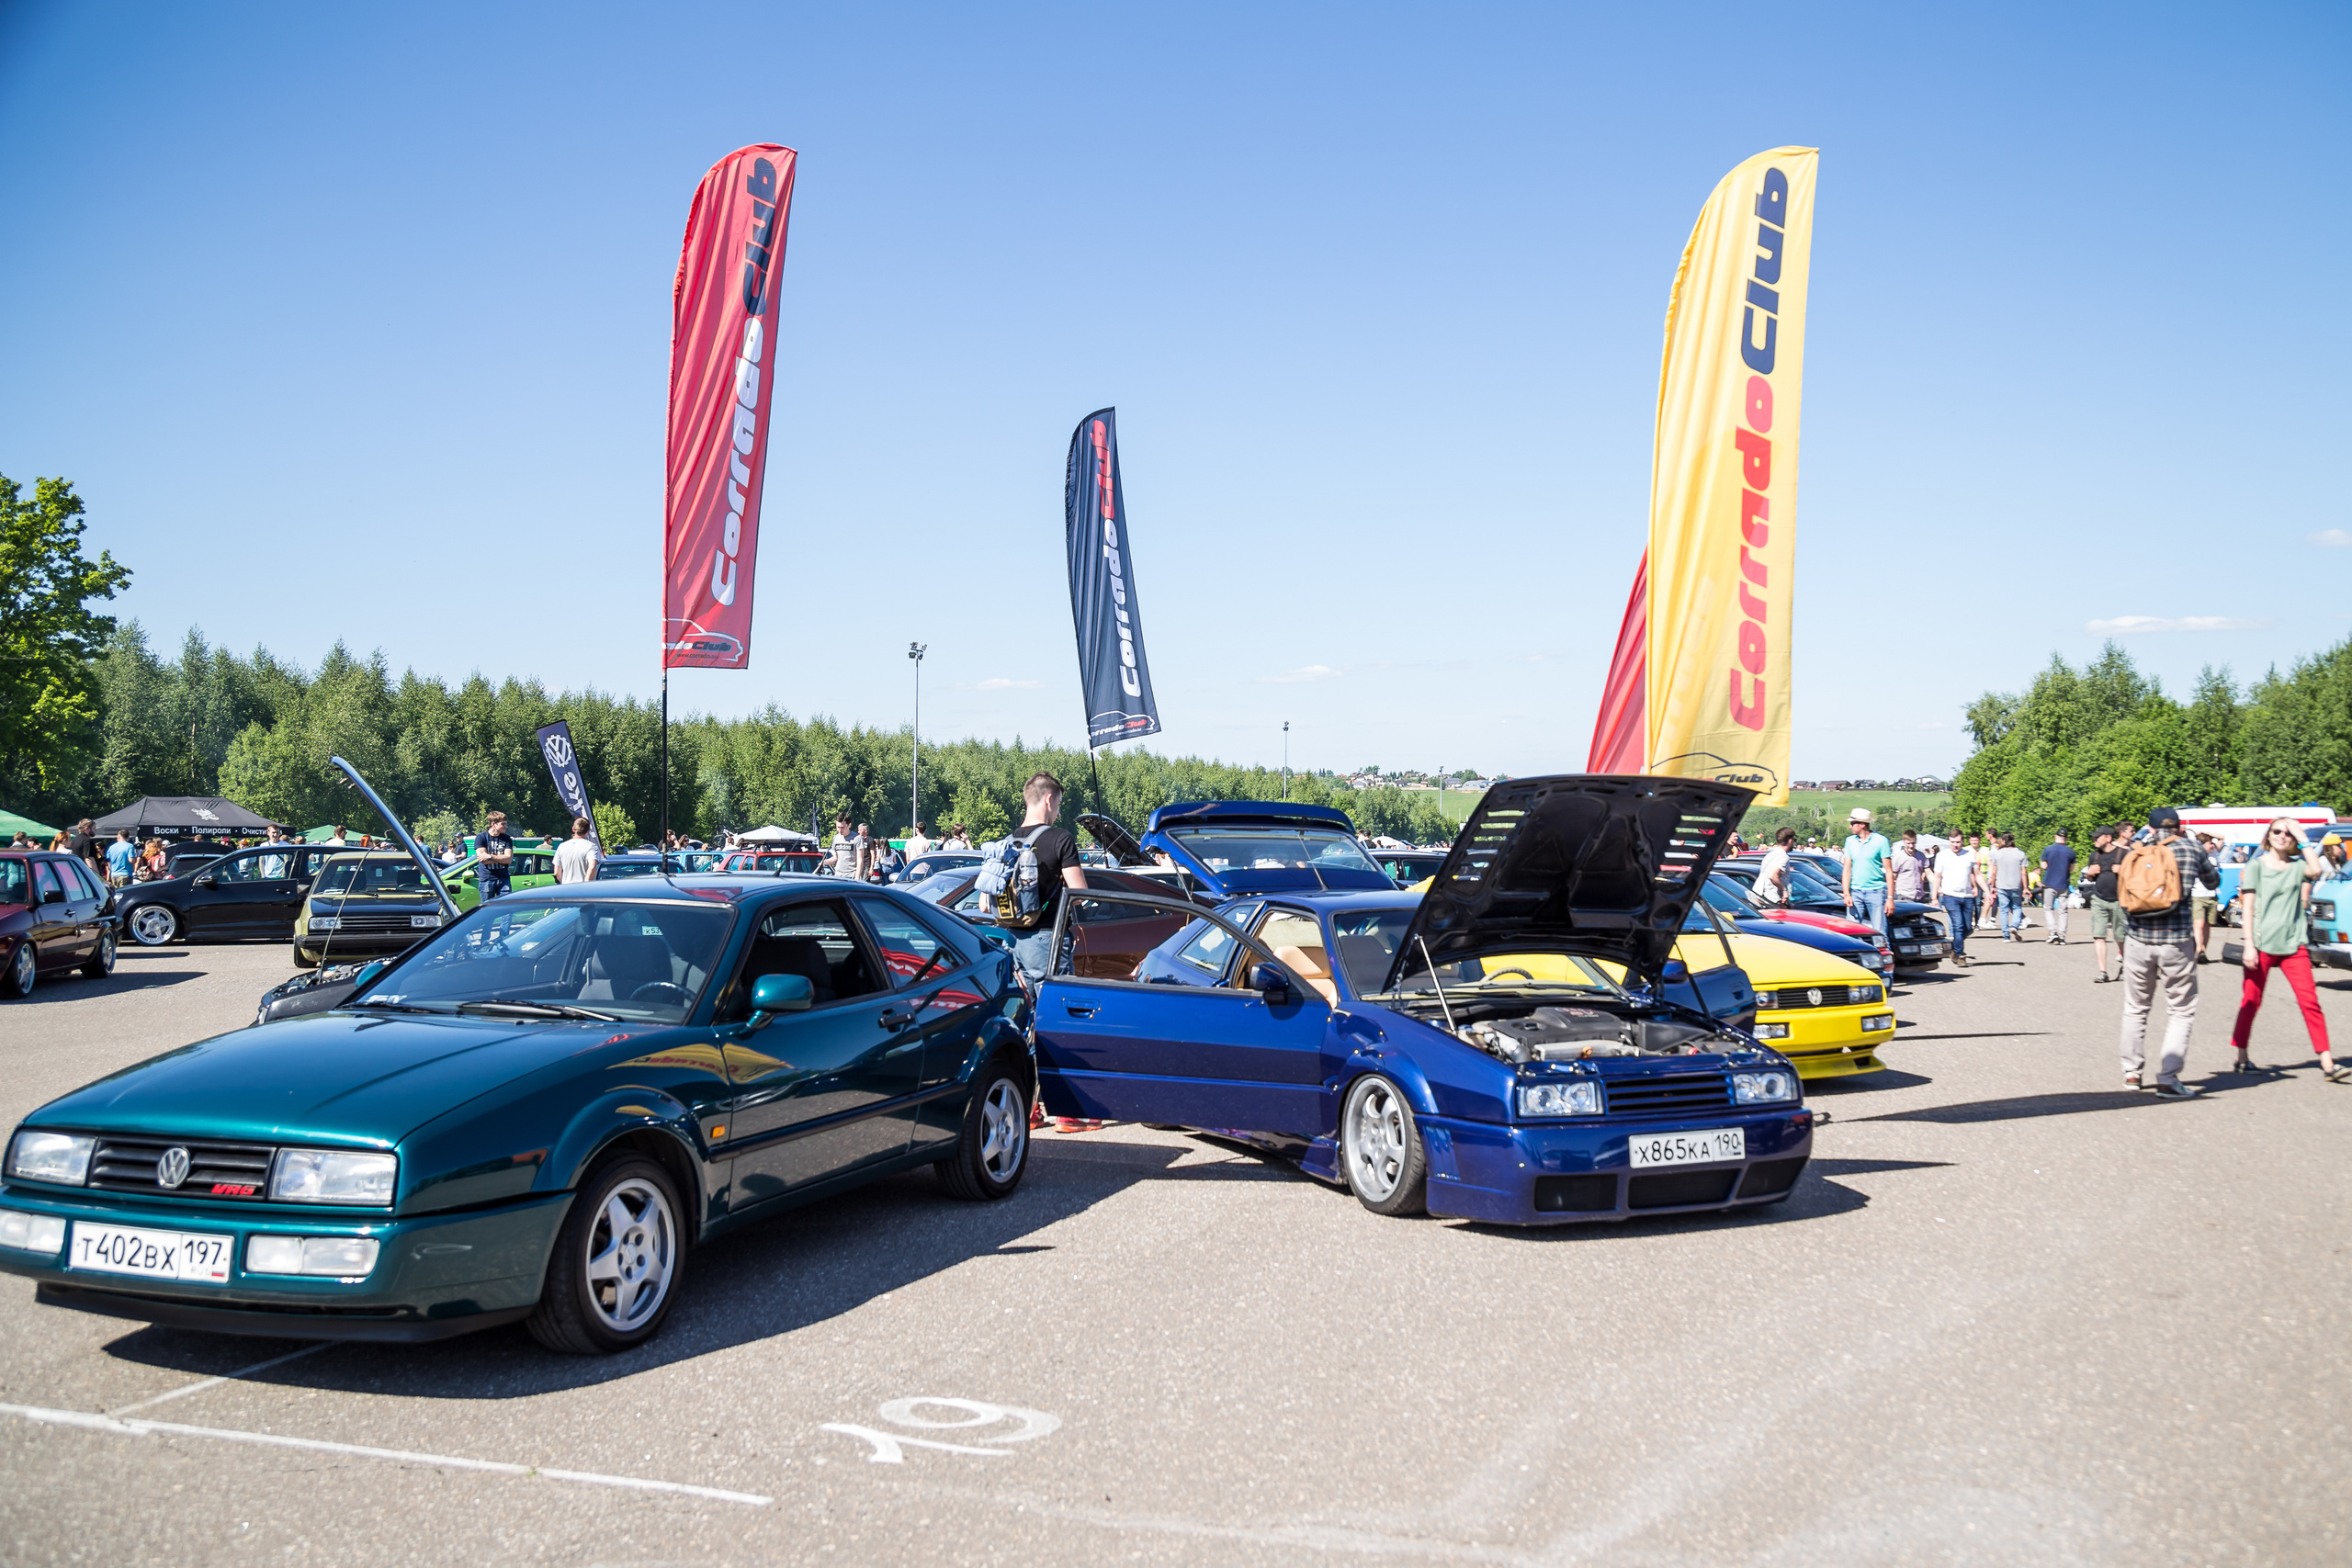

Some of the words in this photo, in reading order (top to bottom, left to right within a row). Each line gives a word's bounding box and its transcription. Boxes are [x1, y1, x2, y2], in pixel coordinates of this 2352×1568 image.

[191, 826, 232, 835] Полироли
[1714, 1133, 1739, 1153] 190
[184, 1240, 223, 1265] 197
